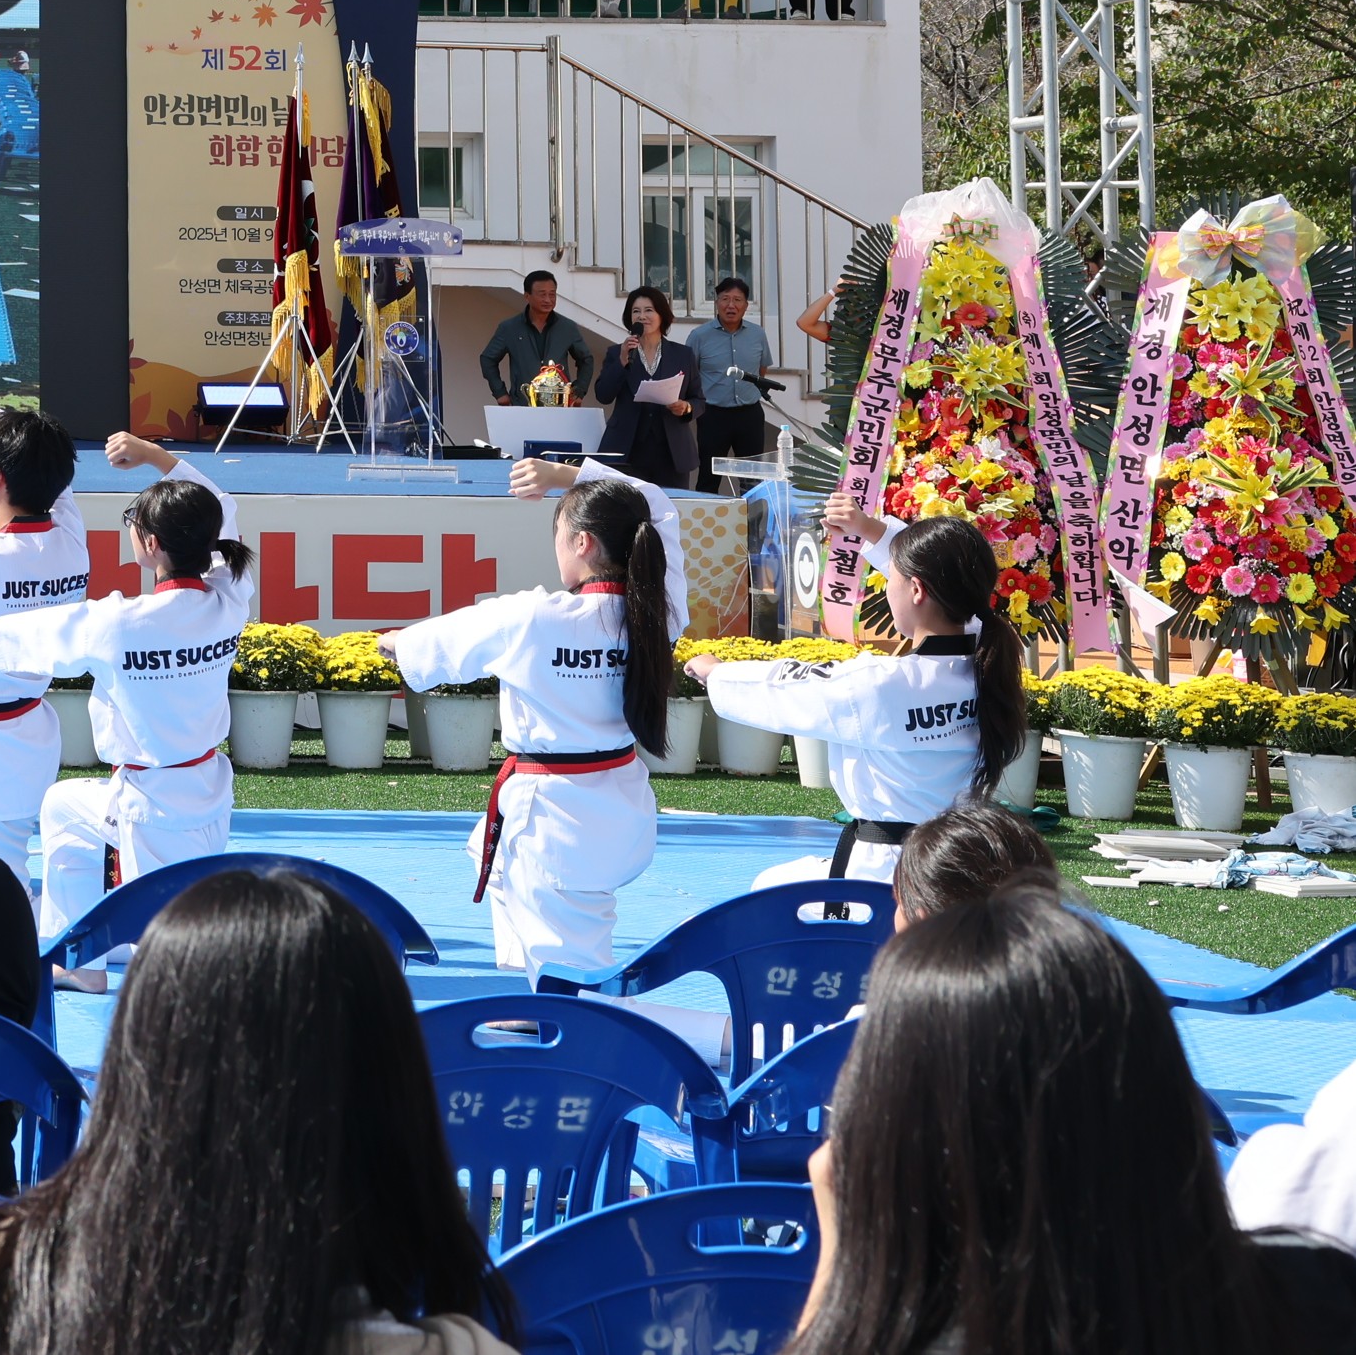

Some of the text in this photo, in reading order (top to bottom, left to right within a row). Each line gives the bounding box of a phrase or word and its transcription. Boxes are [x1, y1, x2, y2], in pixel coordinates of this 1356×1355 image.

[201, 46, 287, 72] 제52회
[143, 93, 267, 127] 안성면민의
[208, 134, 263, 167] 화합
[178, 227, 228, 243] 2025년
[231, 228, 261, 243] 10월
[179, 279, 221, 294] 안성면
[880, 288, 911, 341] 재경
[1287, 298, 1309, 317] 祝
[1137, 292, 1174, 360] 재경
[849, 342, 902, 473] 무주군민회
[1037, 391, 1078, 469] 안성면민의
[2, 581, 40, 600] JUST
[122, 650, 171, 671] JUST
[552, 647, 603, 669] JUST
[556, 671, 603, 679] Taekwondo
[905, 702, 957, 732] JUST
[448, 1090, 591, 1133] 안성면
